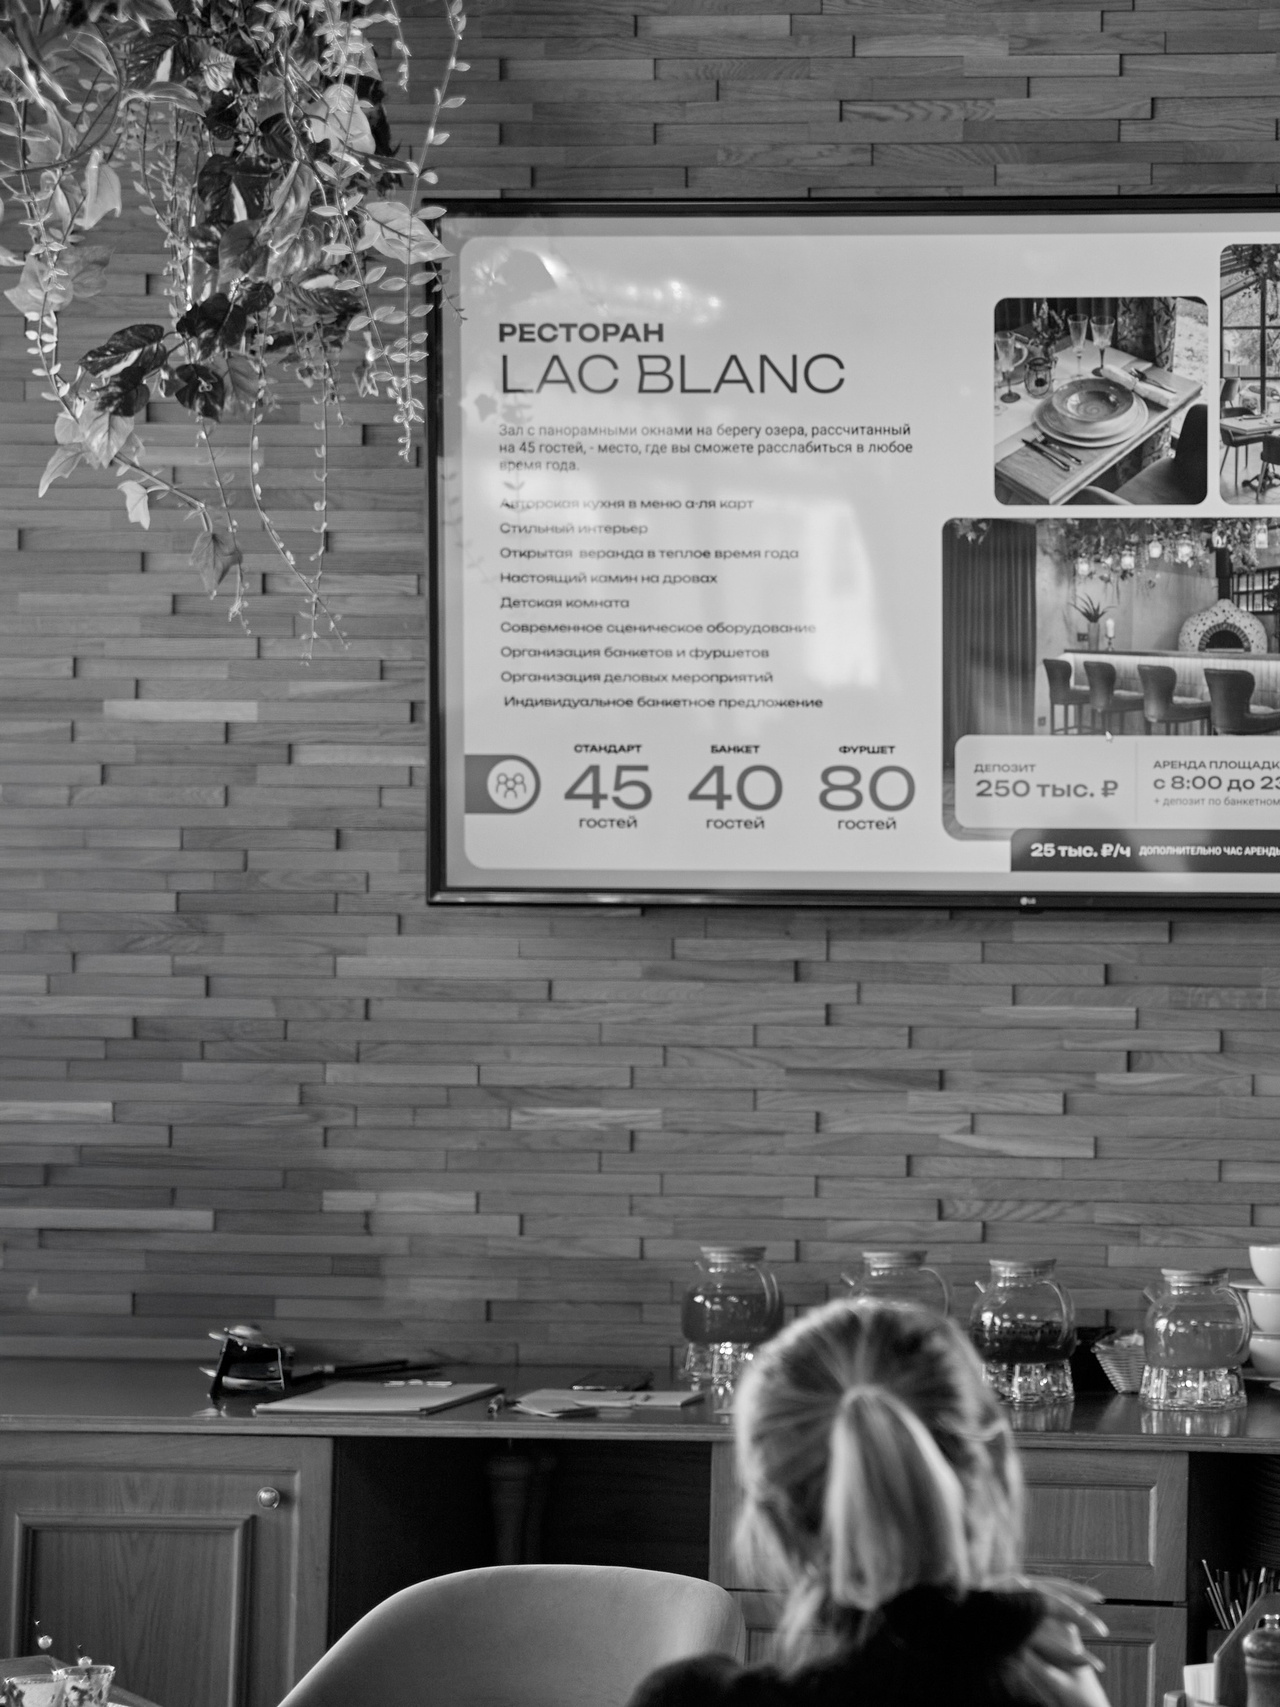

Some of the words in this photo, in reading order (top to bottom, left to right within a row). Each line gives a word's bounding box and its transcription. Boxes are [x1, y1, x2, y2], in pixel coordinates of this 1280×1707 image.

[498, 322, 664, 344] РЕСТОРАН
[501, 353, 619, 395] LAC
[637, 353, 845, 395] BLANC
[498, 423, 524, 437] Зал
[538, 426, 638, 439] панорамными
[640, 426, 693, 437] окнами
[696, 426, 713, 437] на
[716, 423, 762, 440] берегу
[764, 425, 808, 439] озера,
[810, 422, 912, 439] рассчитанный
[498, 443, 516, 454] на
[518, 440, 536, 455] 45
[538, 441, 587, 456] гостей,
[597, 443, 642, 456] место,
[644, 443, 668, 456] где
[670, 443, 691, 454] вы
[693, 443, 755, 454] сможете
[757, 440, 853, 457] расслабиться
[867, 439, 914, 454] любое
[500, 460, 542, 473] время
[546, 460, 580, 472] года.
[583, 500, 625, 511] кухня
[639, 499, 683, 510] меню
[684, 499, 717, 510] а-ля
[719, 499, 754, 511] карт
[499, 521, 575, 535] Стильный
[577, 524, 649, 536] интерьер
[499, 546, 573, 561] Открытая
[579, 549, 645, 561] веранда
[658, 549, 712, 560] теплое
[713, 549, 762, 561] время
[764, 549, 800, 561] года
[499, 572, 588, 585] Настоящий
[590, 574, 639, 584] камин
[640, 574, 660, 584] на
[661, 574, 718, 586] дровах
[499, 595, 563, 610] Детская
[565, 598, 630, 609] комната
[499, 620, 604, 635] Современное
[605, 623, 704, 635] сценическое
[705, 621, 816, 636] оборудование
[499, 645, 602, 660] Организация
[603, 646, 674, 659] банкетов
[688, 647, 770, 661] фуршетов
[500, 670, 602, 684] Организация
[602, 673, 669, 684] деловых
[671, 671, 774, 685] мероприятий
[503, 695, 635, 710] Индивидуальное
[636, 695, 716, 708] банкетное
[718, 698, 824, 710] предложение
[573, 743, 643, 755] СТАНДАРТ
[710, 744, 761, 755] БАНКЕТ
[838, 744, 896, 755] ФУРШЕТ
[972, 763, 1037, 775] ДЕПОЗИТ
[1152, 759, 1207, 771] АРЕНДА
[564, 765, 652, 810] 45
[687, 764, 784, 812] 40
[818, 764, 916, 813] 80
[975, 778, 1031, 798] 250
[1035, 783, 1095, 799] тыс.
[1170, 775, 1223, 791] 8:00
[1226, 778, 1256, 793] до
[1162, 797, 1206, 807] депозит
[1207, 797, 1222, 807] по
[578, 815, 638, 830] гостей
[705, 815, 766, 830] гостей
[837, 816, 897, 831] гостей
[1030, 843, 1056, 858] 25
[1056, 845, 1099, 858] тыс.
[1138, 845, 1223, 857] ДОПОЛНИТЕЛЬНО
[1222, 845, 1244, 856] ЧАС
